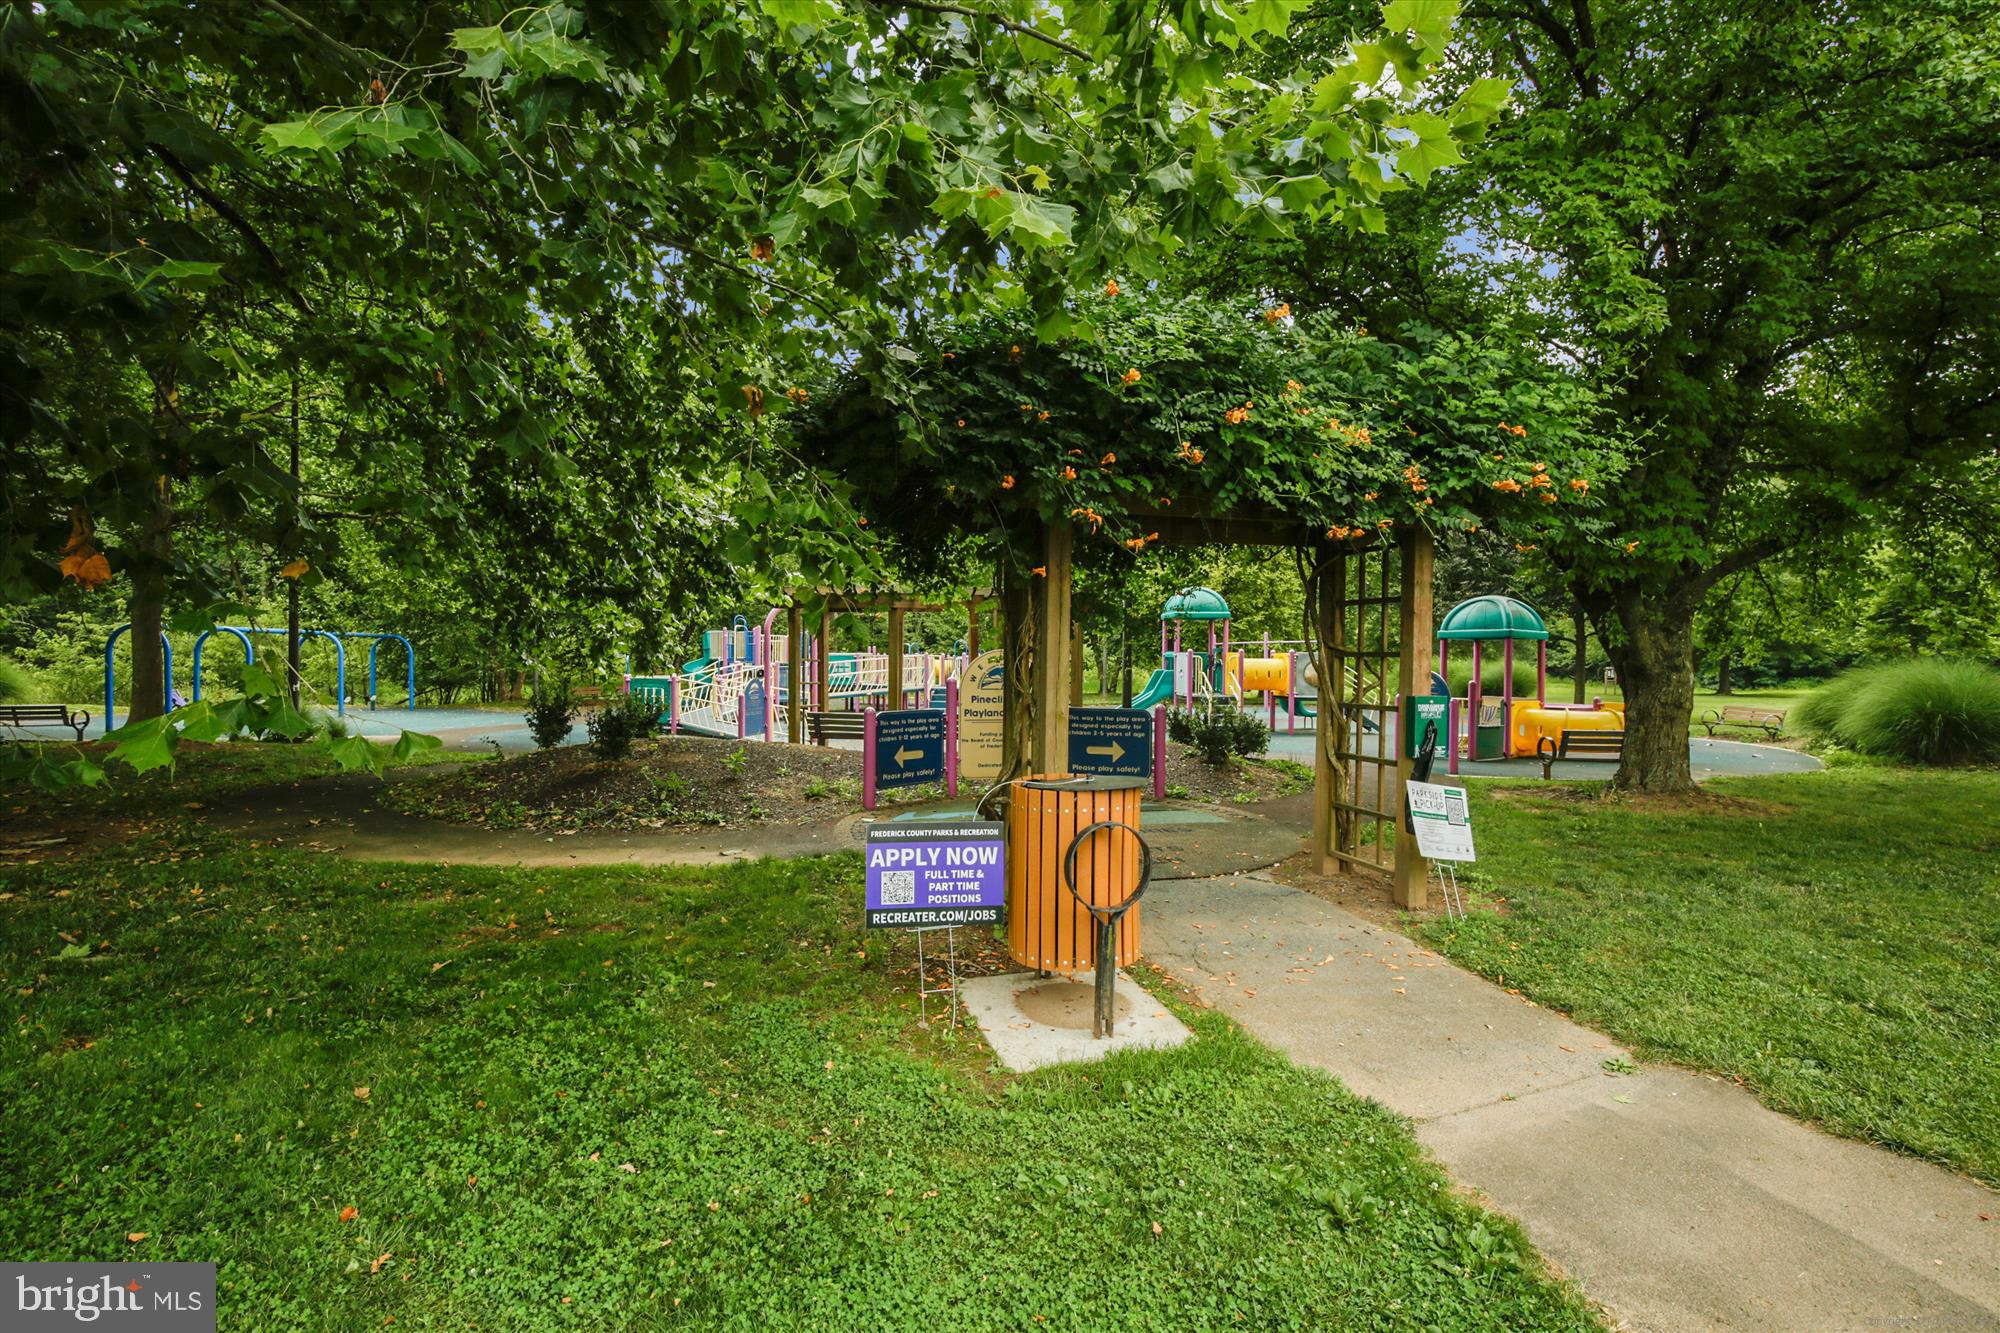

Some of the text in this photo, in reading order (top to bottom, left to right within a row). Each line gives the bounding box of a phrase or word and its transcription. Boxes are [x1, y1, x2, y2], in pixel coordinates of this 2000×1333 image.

[971, 695, 1003, 704] Pinecli
[902, 771, 914, 779] play
[916, 768, 935, 776] safely!
[1098, 765, 1113, 773] play
[870, 829, 906, 838] FREDERICK
[906, 829, 932, 837] COUNTY
[960, 828, 999, 836] RECREATION
[870, 846, 998, 868] APPLY NOW
[924, 869, 984, 879] FULL TIME &
[928, 881, 980, 891] PART TIME
[928, 894, 981, 904] POSITIONS
[872, 909, 997, 924] RECREATER.COM/JOBS
